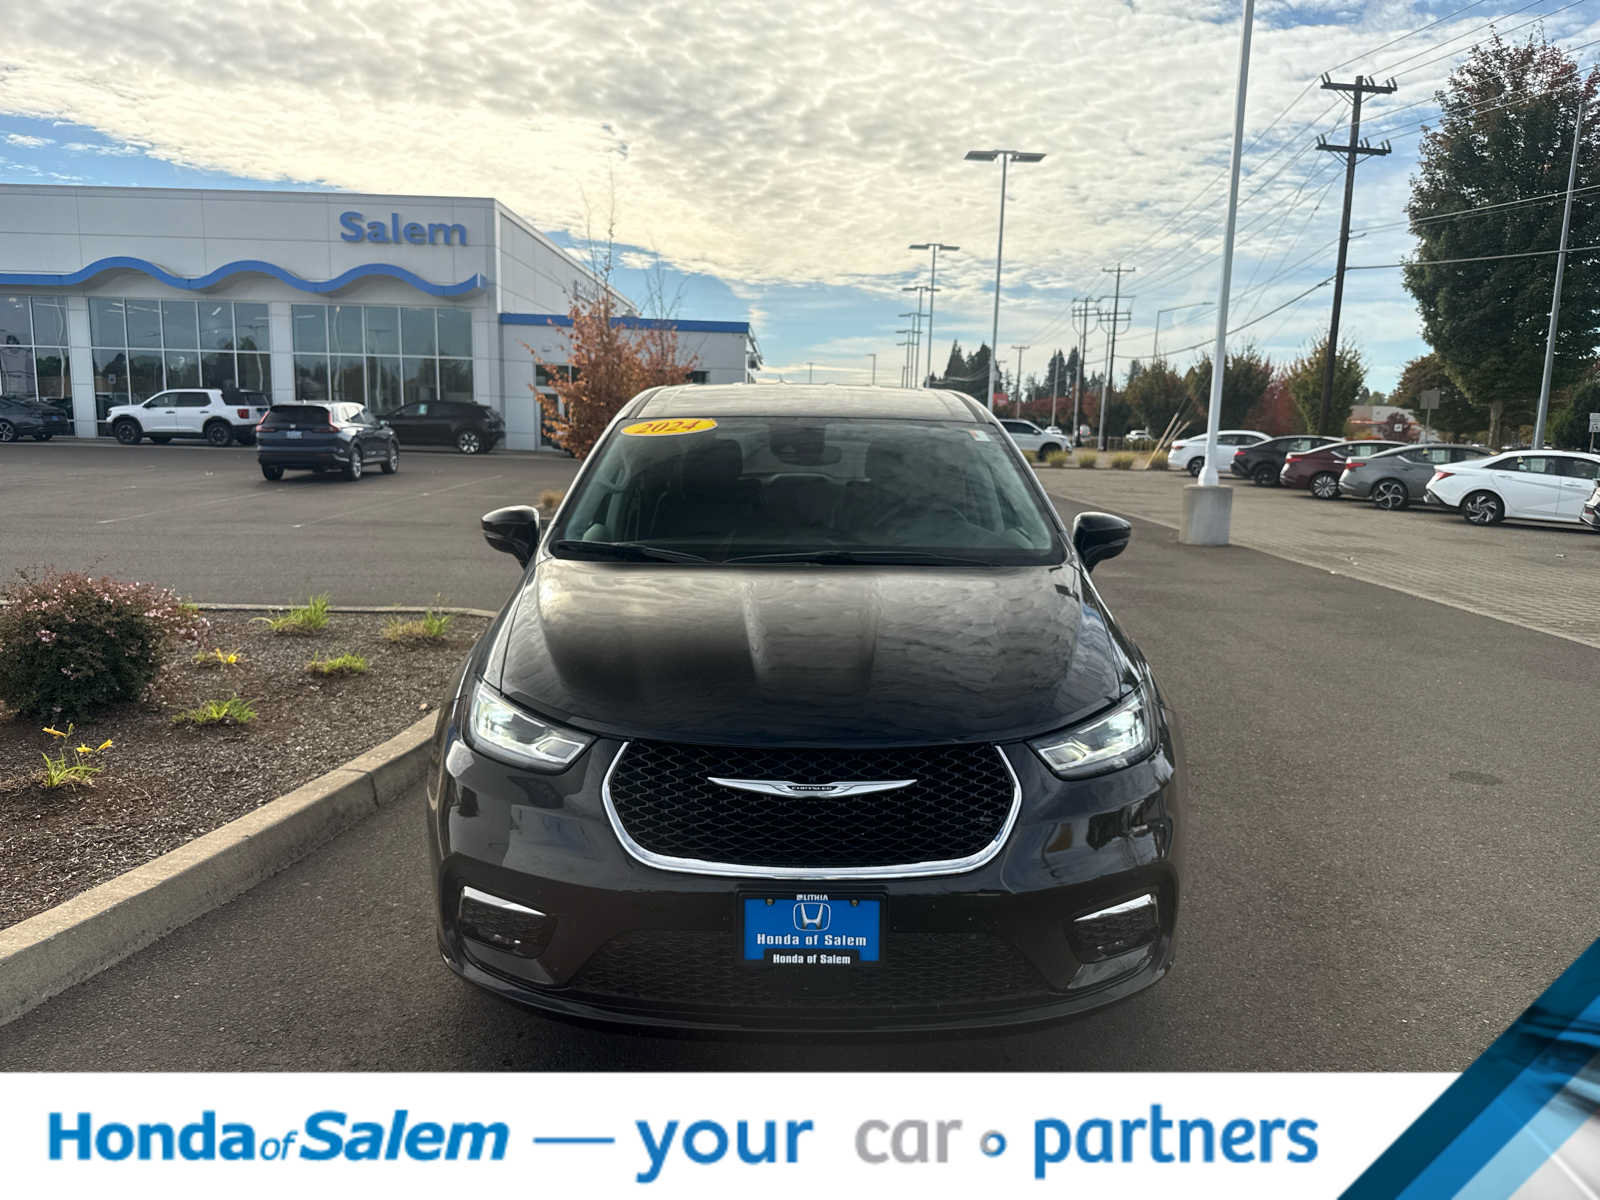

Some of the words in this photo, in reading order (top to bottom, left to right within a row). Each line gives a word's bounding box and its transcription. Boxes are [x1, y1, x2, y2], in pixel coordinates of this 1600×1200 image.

[339, 211, 467, 246] Salem
[633, 420, 701, 434] 2024
[757, 933, 800, 945] Honda
[805, 933, 818, 945] of
[824, 934, 867, 946] Salem
[773, 954, 804, 964] Honda
[807, 954, 817, 964] of
[820, 954, 851, 964] Salem
